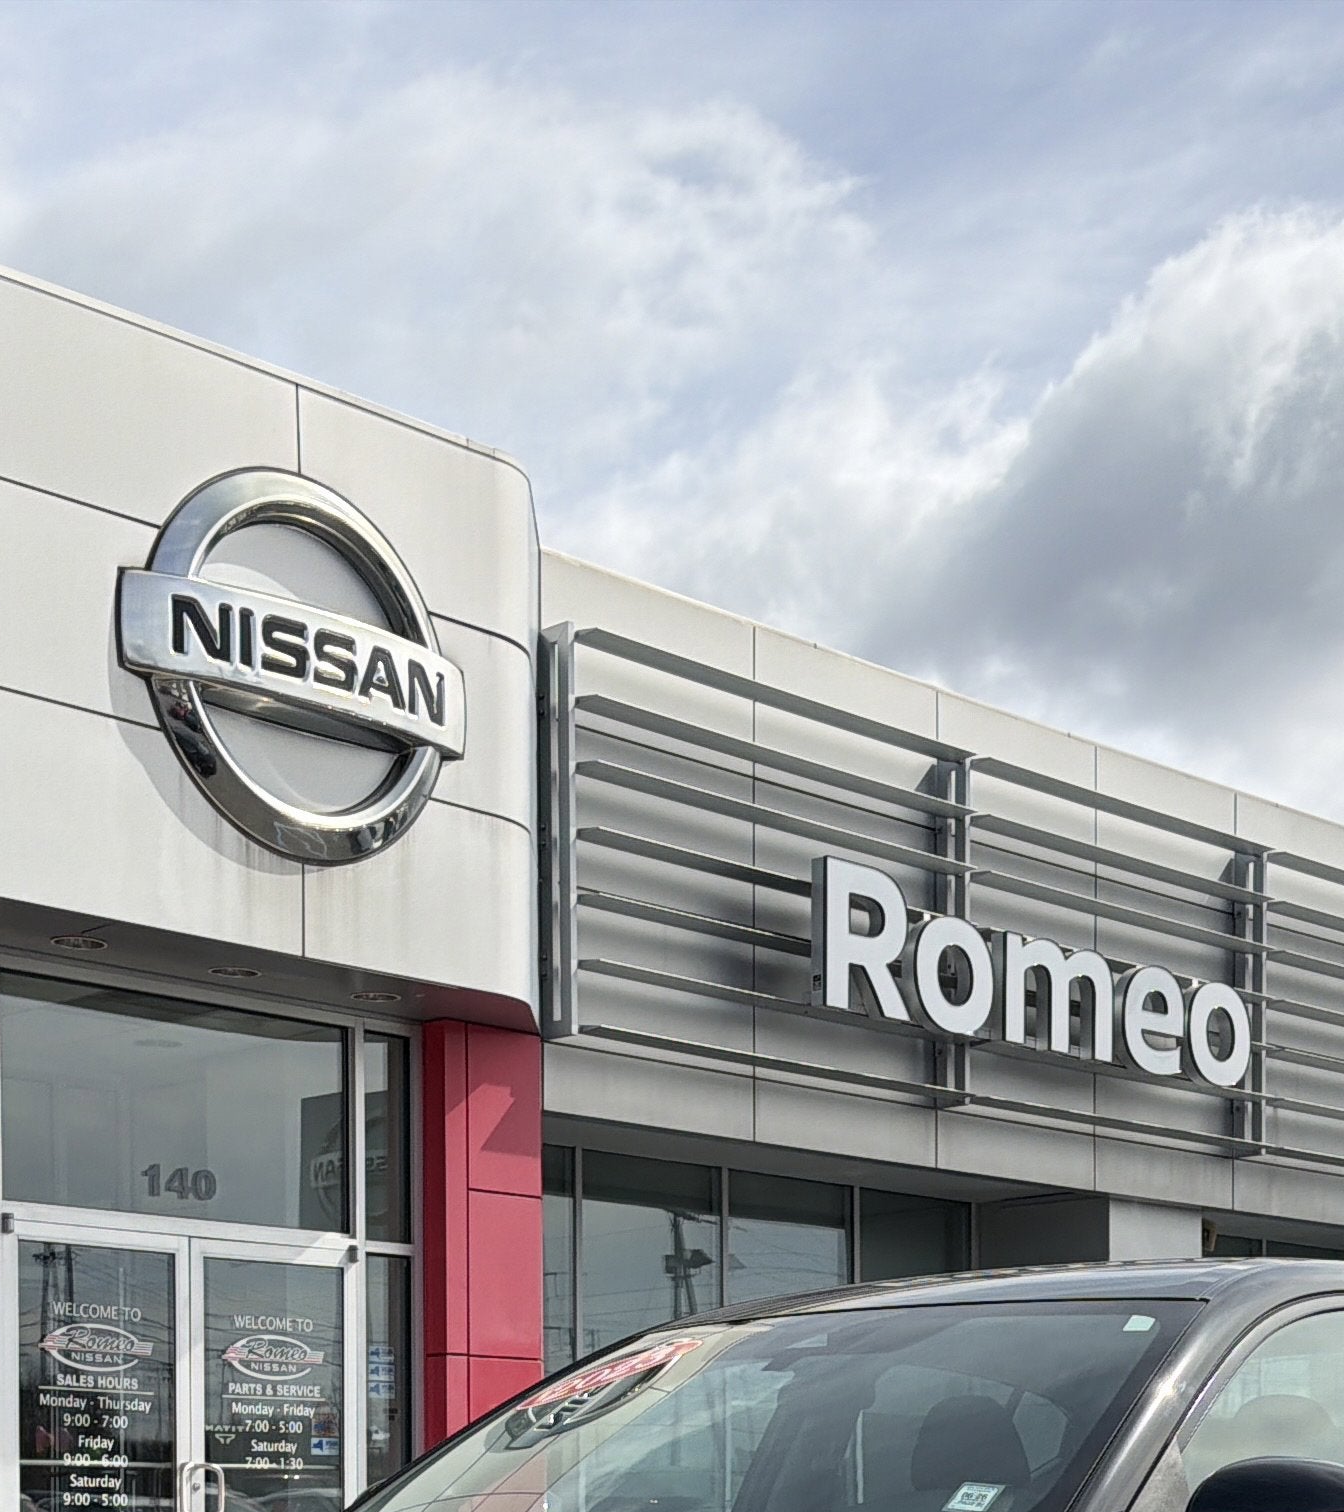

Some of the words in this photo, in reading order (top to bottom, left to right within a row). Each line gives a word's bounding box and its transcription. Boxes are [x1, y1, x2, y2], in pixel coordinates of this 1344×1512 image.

[169, 592, 447, 728] NISSAN
[814, 854, 1252, 1088] Romeo
[140, 1163, 217, 1201] 140
[52, 1301, 119, 1320] WELCOME
[123, 1307, 142, 1321] TO
[233, 1314, 294, 1331] WELCOME
[296, 1319, 314, 1332] TO
[64, 1326, 136, 1352] Romeo
[244, 1338, 308, 1360] Romeo
[70, 1352, 124, 1364] NISSAN
[250, 1362, 297, 1373] NISSAN
[56, 1373, 95, 1388] SALES
[97, 1376, 139, 1390] HOURS
[228, 1382, 263, 1395] PARTS
[265, 1383, 274, 1396] &
[275, 1384, 321, 1398] SERVICE
[39, 1393, 88, 1410] Monday
[97, 1396, 152, 1414] Thursday
[231, 1402, 275, 1418] Monday
[283, 1403, 316, 1419] Friday
[63, 1413, 91, 1427] 9:00
[101, 1415, 129, 1429] 7:00
[244, 1419, 270, 1433] 7:00
[279, 1421, 303, 1434] 5:00
[78, 1434, 114, 1451] Friday
[250, 1439, 298, 1454] Saturday
[63, 1453, 91, 1466] 9:00
[101, 1454, 129, 1468] 6:00
[244, 1457, 270, 1470] 7:00
[279, 1457, 304, 1470] 1:30
[69, 1473, 122, 1490] Saturday
[63, 1492, 91, 1506] 9:00
[101, 1493, 129, 1507] 5:00
